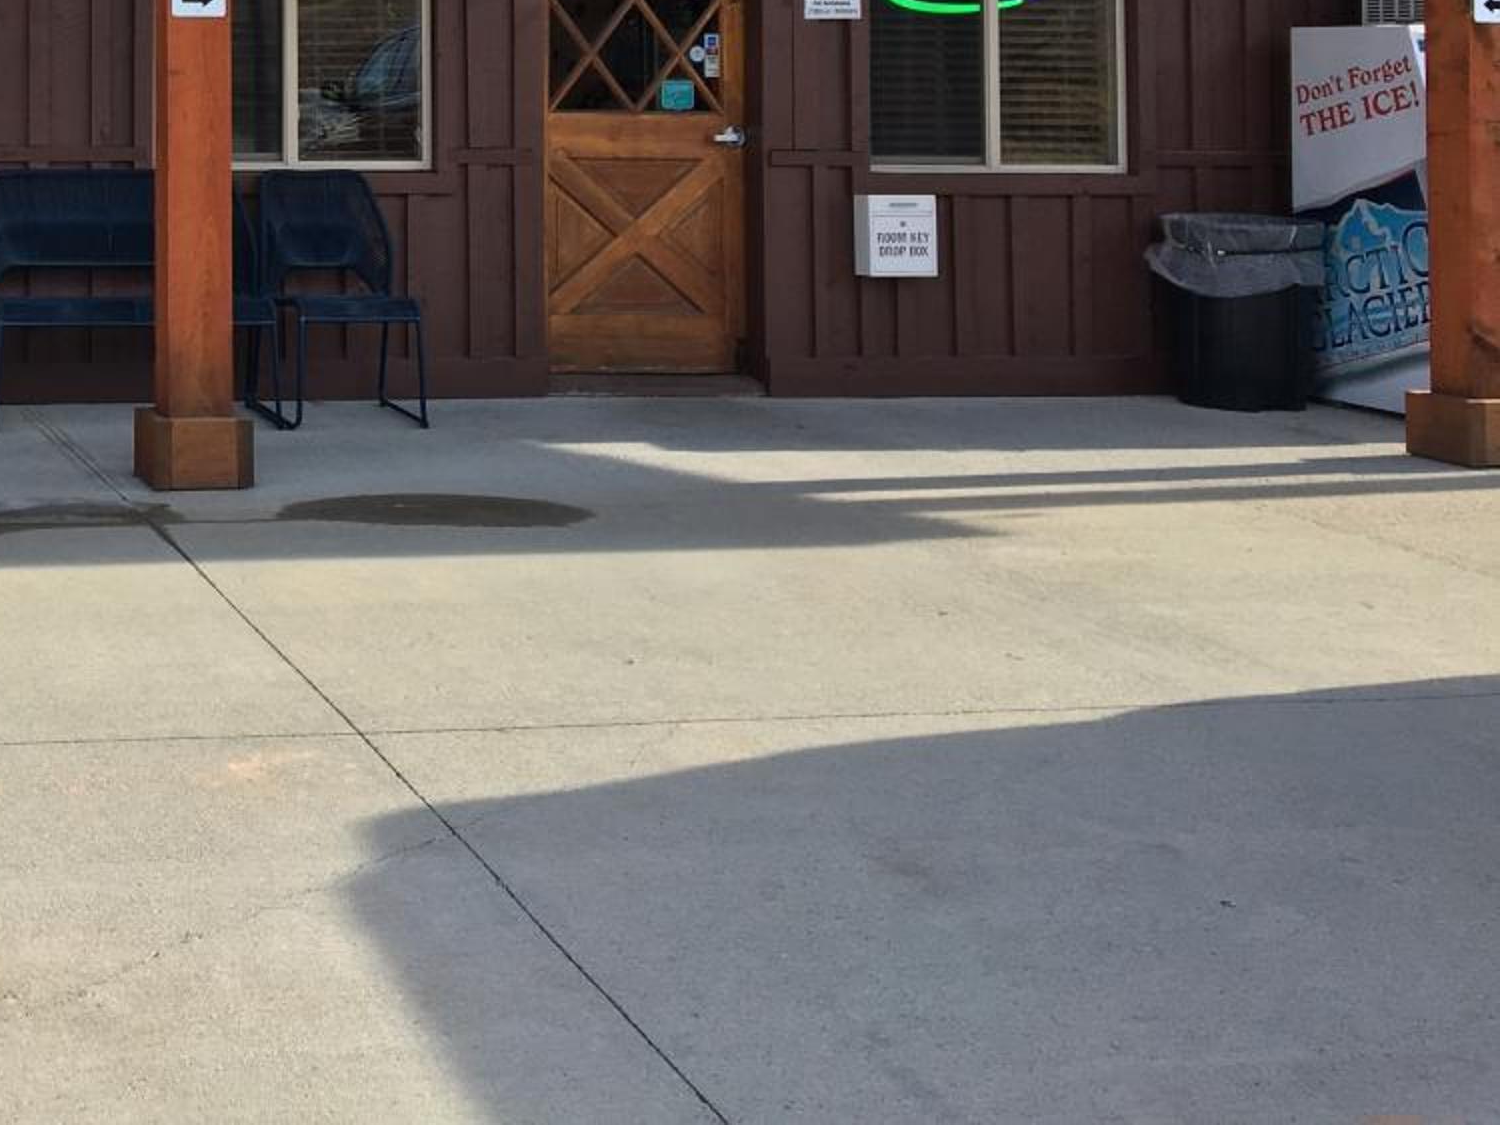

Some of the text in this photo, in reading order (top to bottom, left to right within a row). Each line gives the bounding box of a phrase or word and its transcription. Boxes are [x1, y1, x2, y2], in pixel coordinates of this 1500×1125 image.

[1296, 55, 1412, 105] Don't Forget
[1299, 79, 1419, 136] THE ICE!
[876, 232, 930, 244] ROOM KEY
[879, 246, 929, 256] DROP BOX
[1317, 222, 1428, 304] RCTIC
